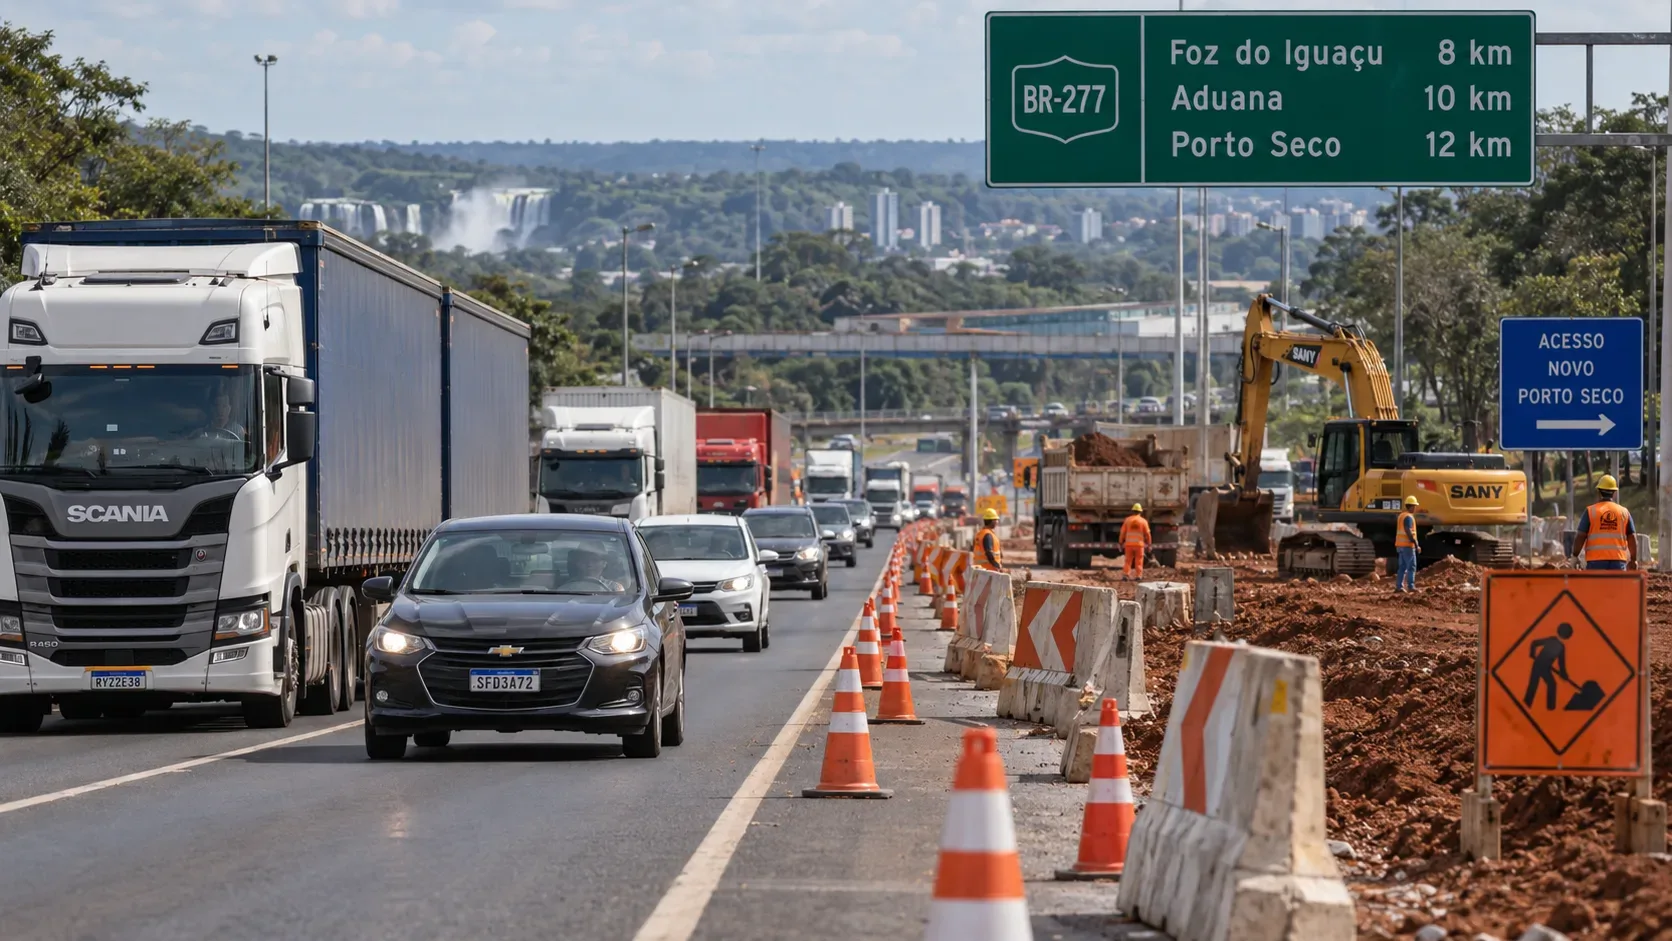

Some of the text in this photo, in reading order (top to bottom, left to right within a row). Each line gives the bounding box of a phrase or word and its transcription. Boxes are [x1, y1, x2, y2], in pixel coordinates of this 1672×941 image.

[1171, 39, 1383, 71] Foz do Iguaçu
[1438, 39, 1512, 65] 8 km
[1024, 85, 1106, 113] BR-277
[1172, 85, 1282, 110] Aduana
[1425, 85, 1512, 110] 10 km
[1173, 131, 1341, 157] Porto Seco
[1426, 131, 1512, 157] 12 km
[1539, 333, 1604, 348] ACESSO
[1292, 346, 1316, 364] SANY
[1549, 361, 1594, 376] NOVO
[1518, 388, 1624, 404] PORTO SECO
[1451, 485, 1503, 499] SANY
[67, 505, 169, 522] SCANIA
[476, 676, 533, 690] SFD3A72
